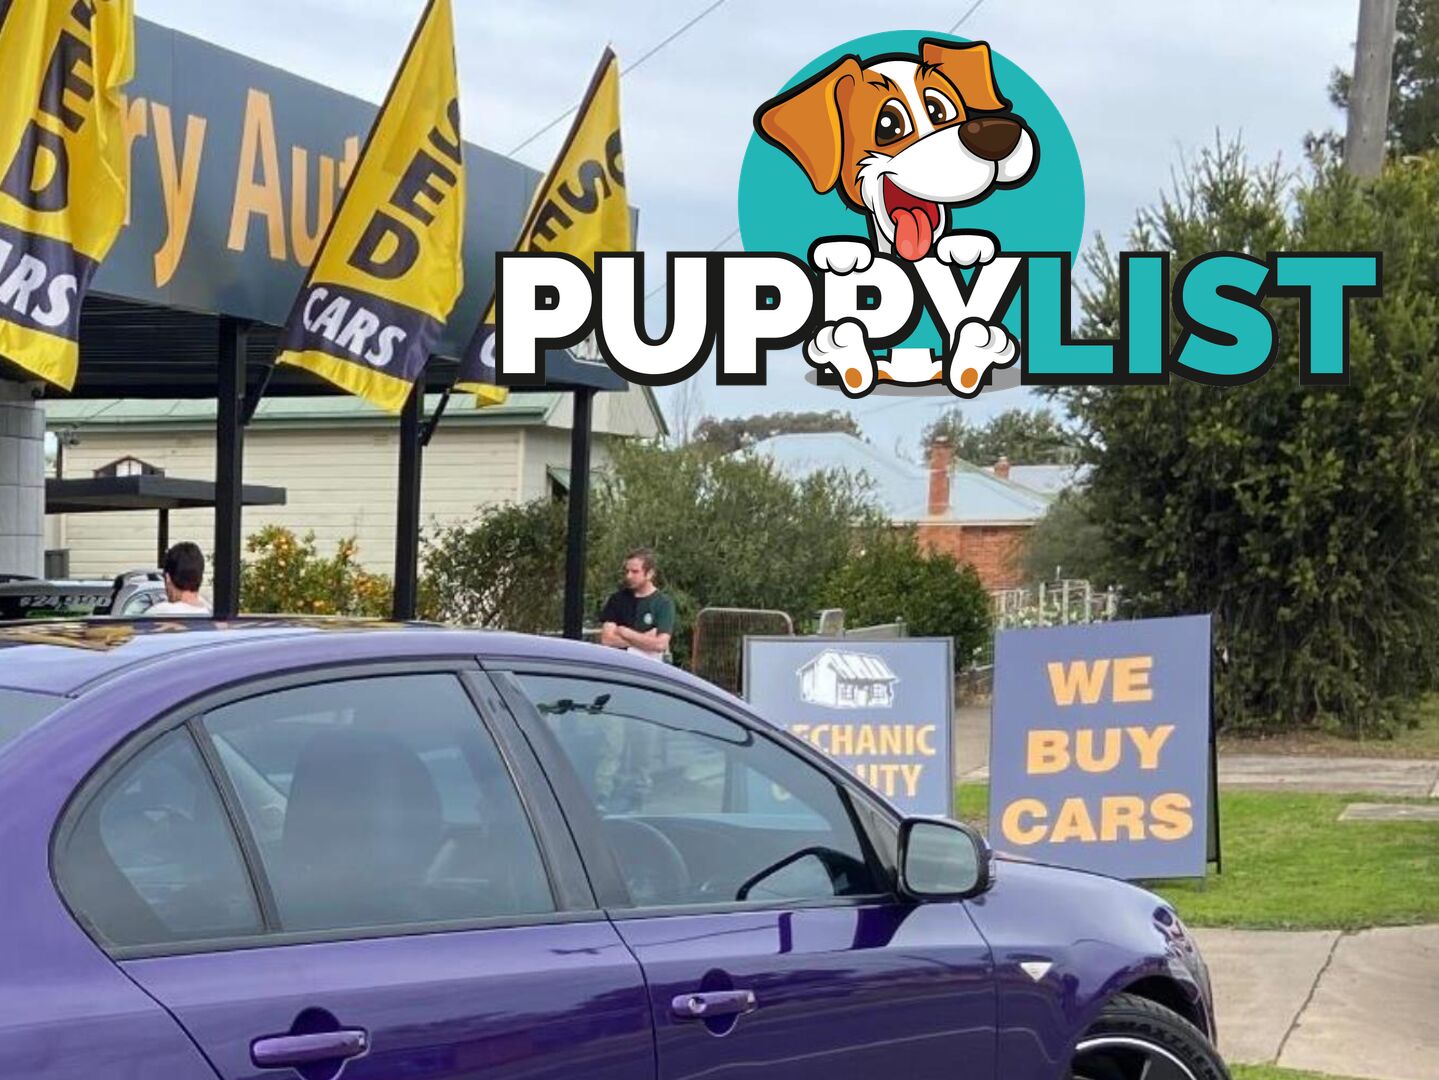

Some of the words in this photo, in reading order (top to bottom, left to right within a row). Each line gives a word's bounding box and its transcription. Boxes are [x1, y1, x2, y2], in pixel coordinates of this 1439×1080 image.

[302, 287, 407, 369] CARS
[1047, 655, 1154, 706] WE
[1025, 724, 1177, 775] BUY
[1000, 792, 1195, 846] CARS
